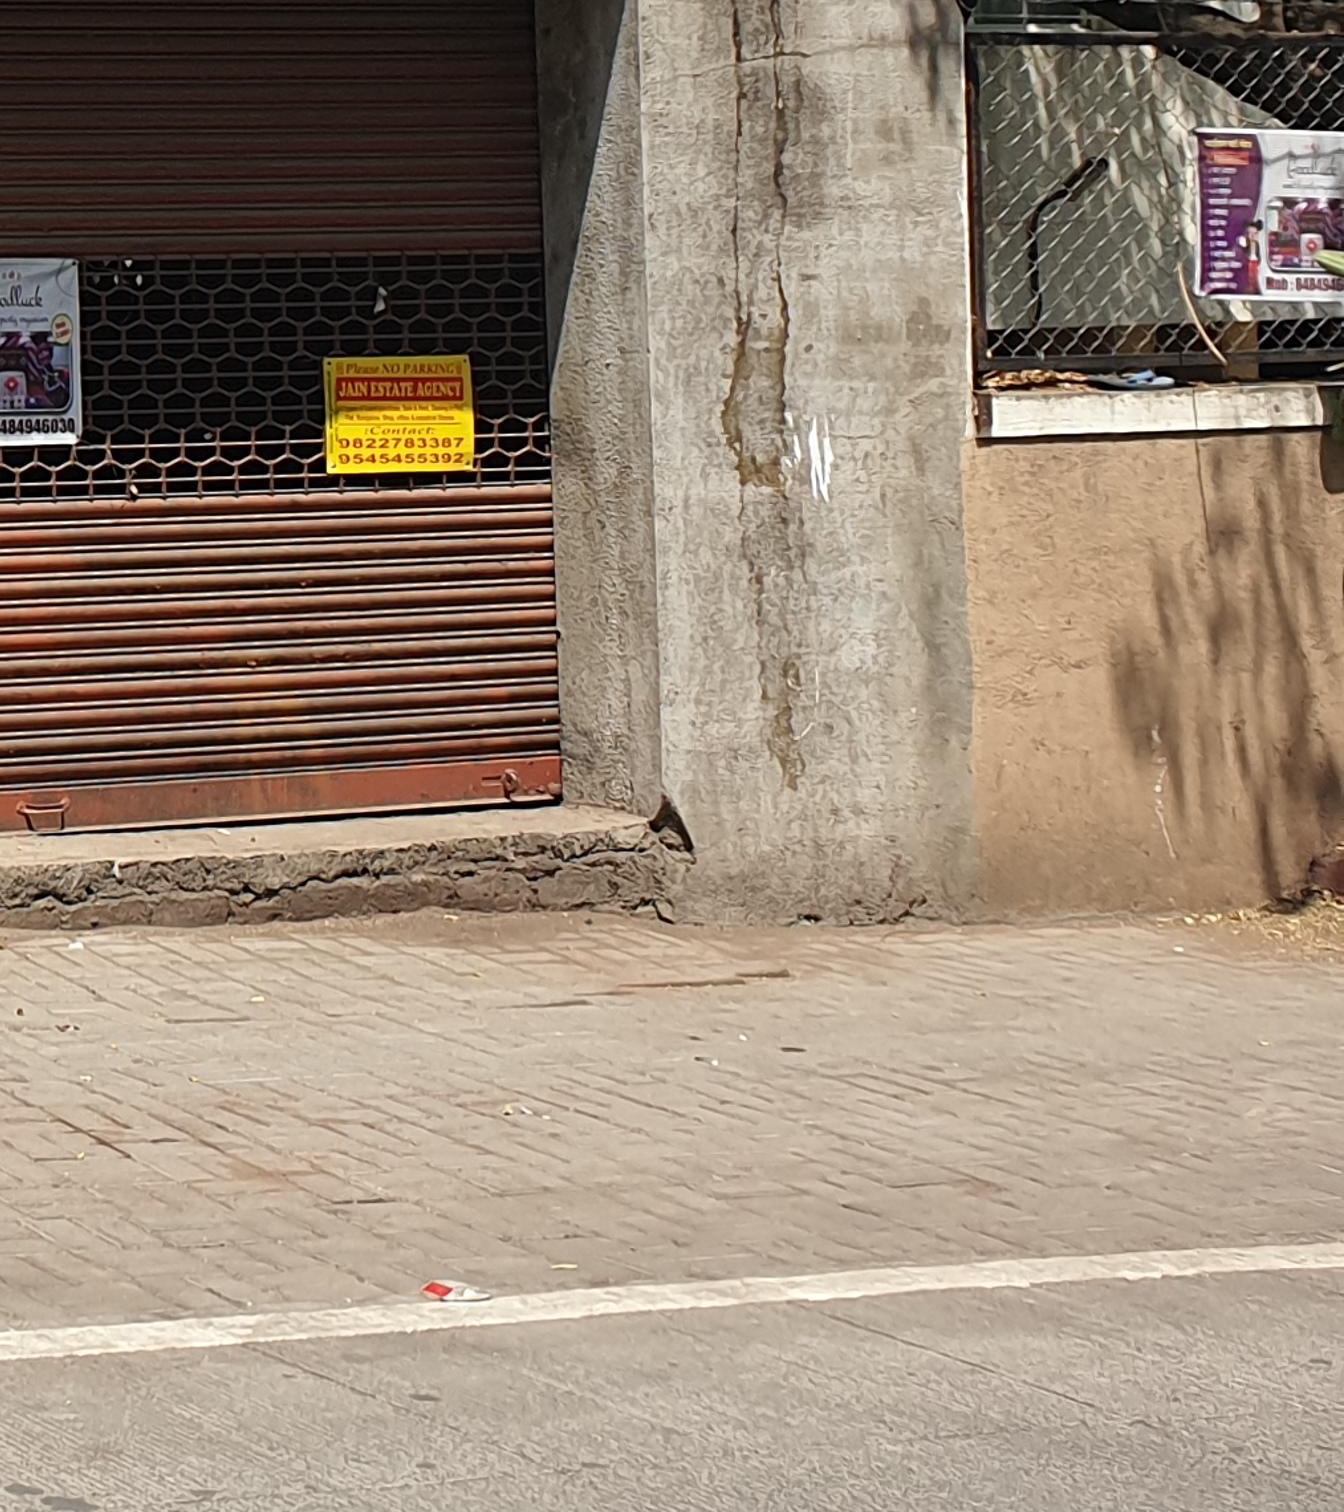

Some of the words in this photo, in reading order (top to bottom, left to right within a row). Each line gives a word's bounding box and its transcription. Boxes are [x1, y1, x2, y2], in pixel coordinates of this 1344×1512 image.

[339, 381, 367, 397] JAIN
[370, 382, 414, 397] ESTATE
[416, 381, 461, 396] AGENCY
[338, 438, 464, 449] 9822783387
[338, 453, 464, 464] 9545455392
